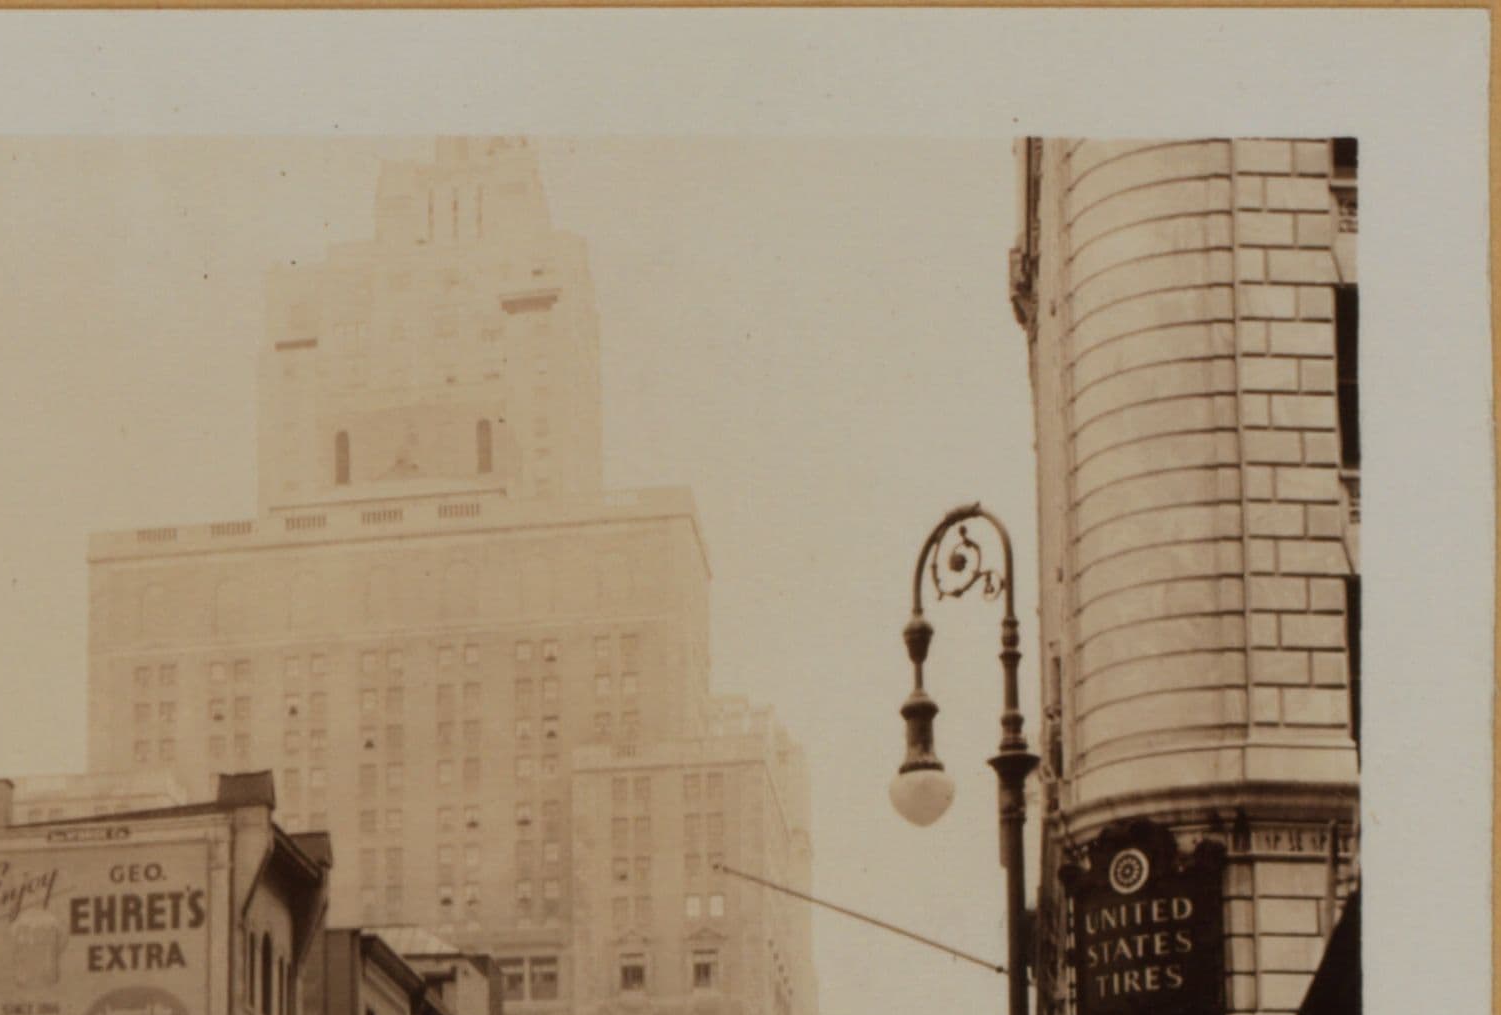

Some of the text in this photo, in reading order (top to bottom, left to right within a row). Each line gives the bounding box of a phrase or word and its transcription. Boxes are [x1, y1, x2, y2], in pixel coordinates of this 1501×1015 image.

[109, 864, 167, 883] GEO.
[70, 886, 205, 935] EHRET'S
[1085, 898, 1193, 935] UNITED
[87, 942, 187, 971] EXTRA
[1087, 932, 1193, 967] STATES
[1096, 966, 1184, 998] TIRES
